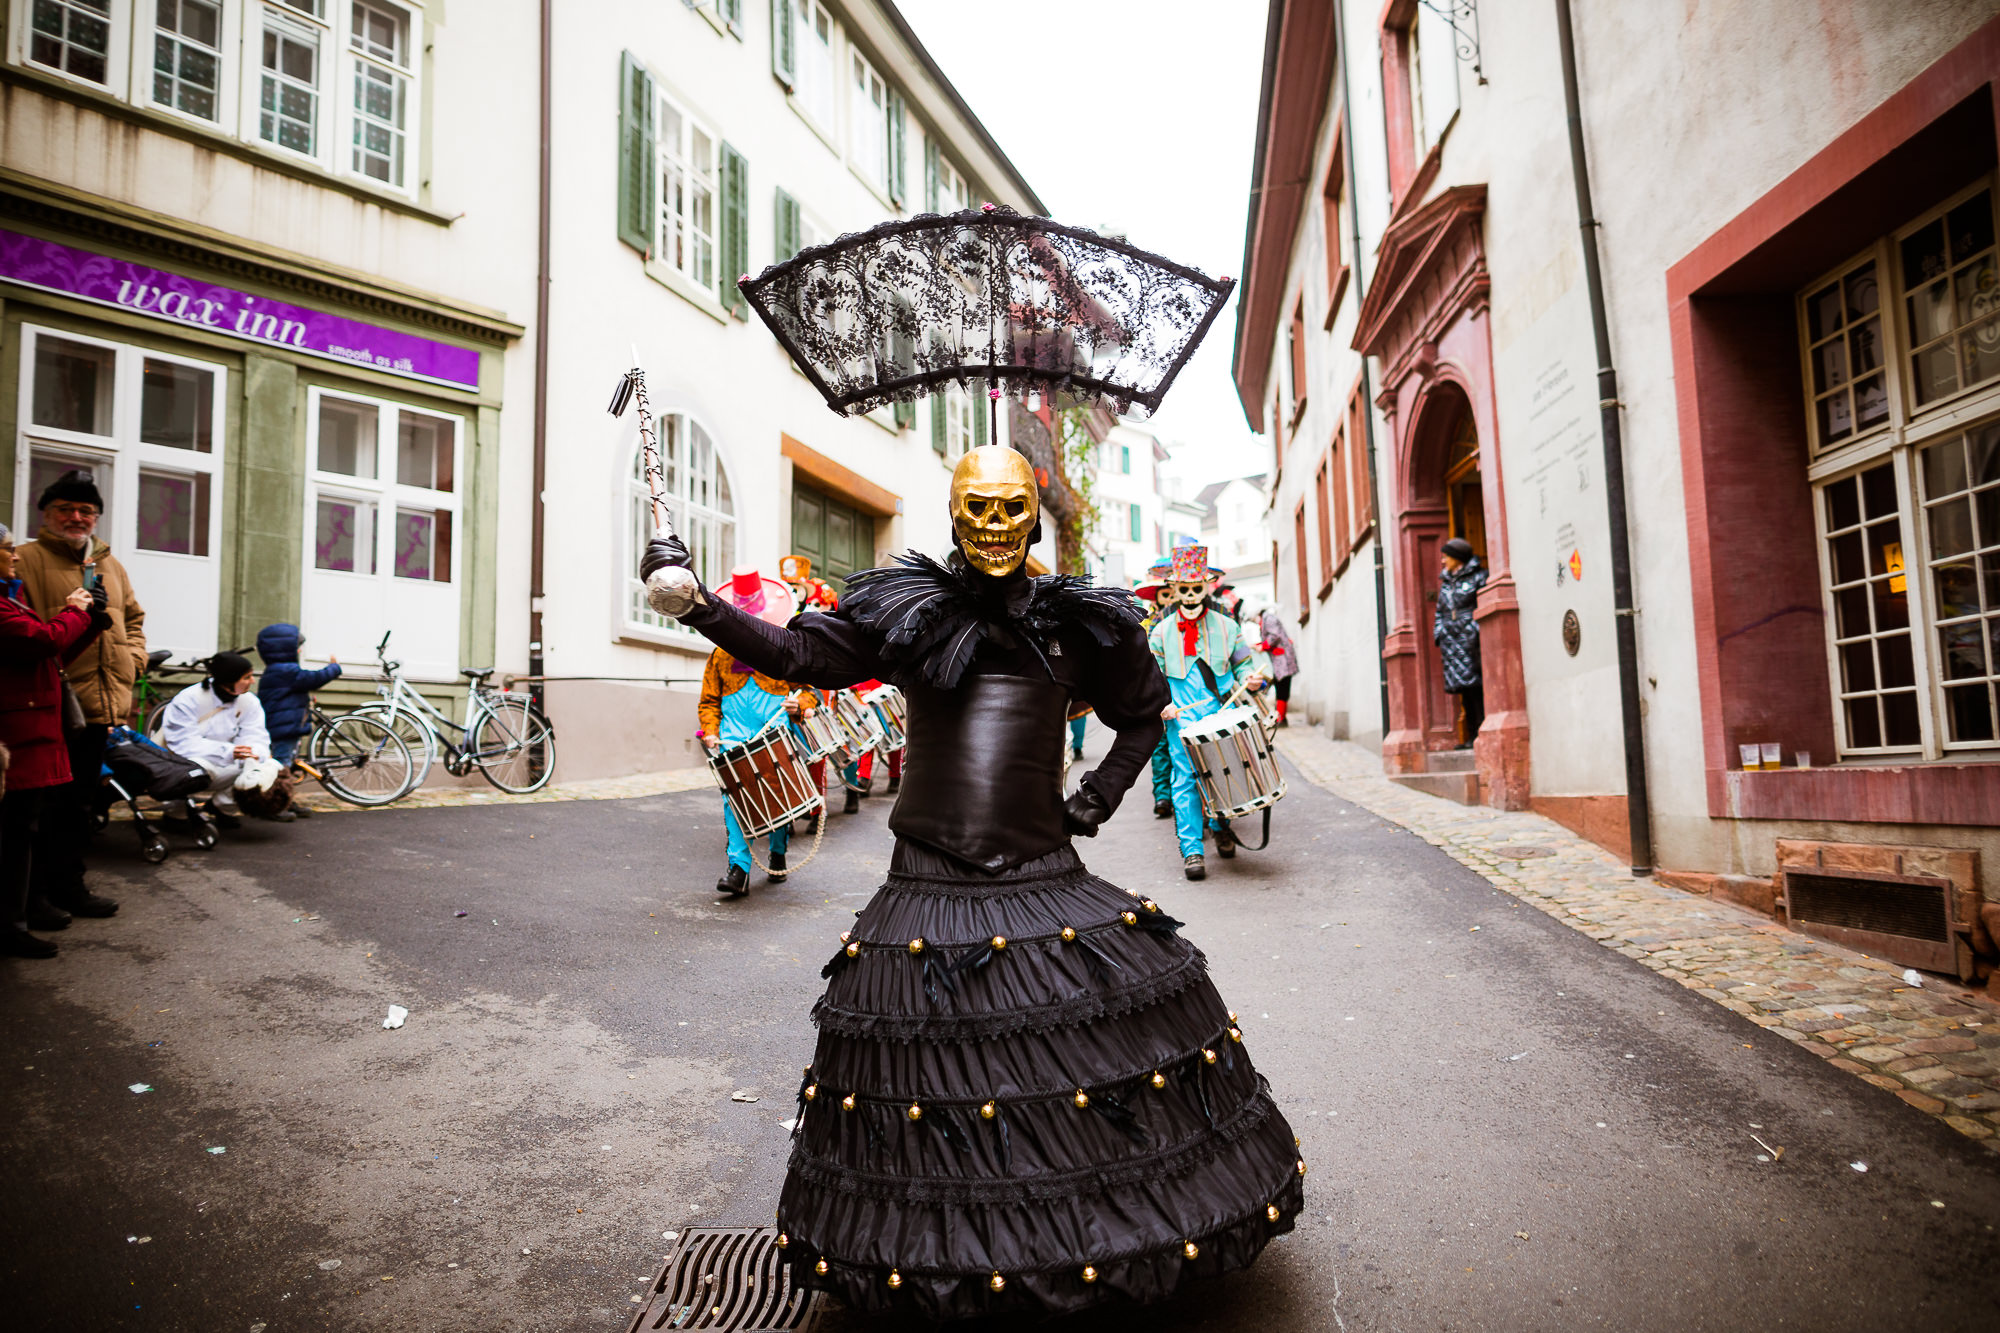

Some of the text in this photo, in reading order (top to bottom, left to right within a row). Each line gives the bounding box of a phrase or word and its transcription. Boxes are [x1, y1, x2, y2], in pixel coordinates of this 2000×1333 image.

[116, 279, 307, 347] wax inn
[328, 344, 413, 371] smooth as silk
